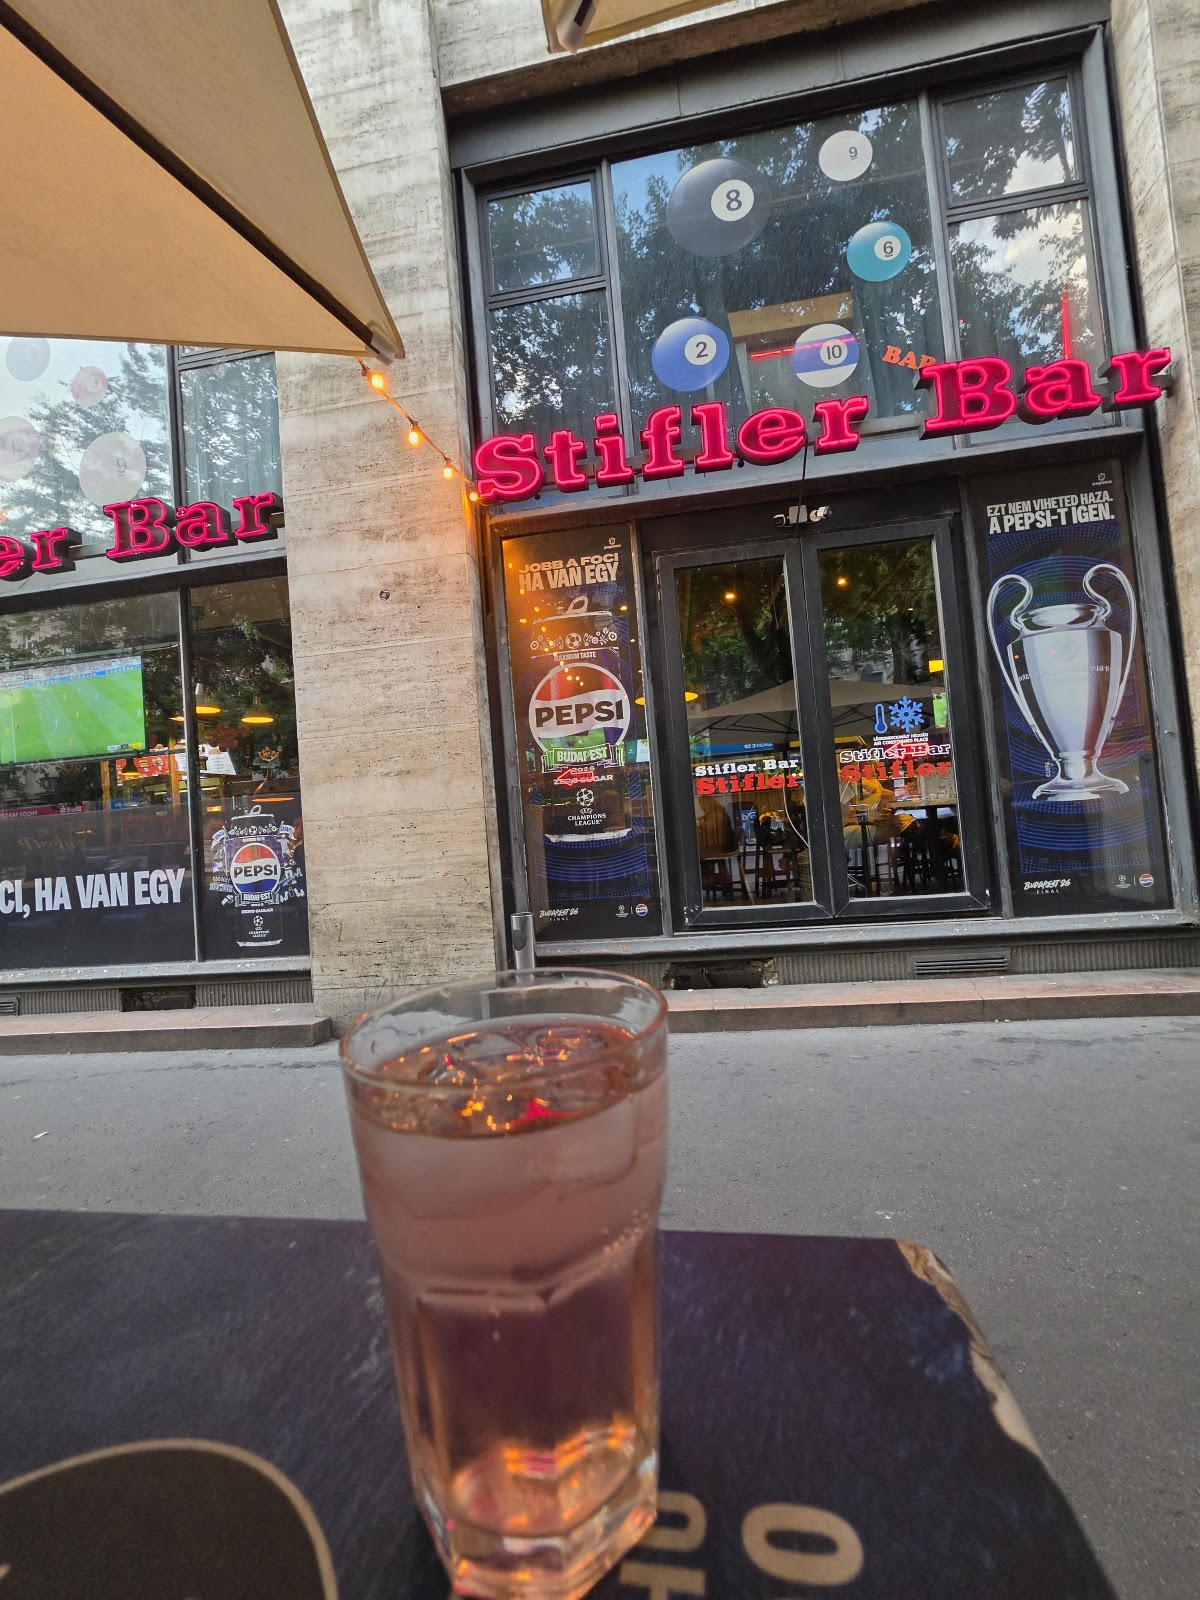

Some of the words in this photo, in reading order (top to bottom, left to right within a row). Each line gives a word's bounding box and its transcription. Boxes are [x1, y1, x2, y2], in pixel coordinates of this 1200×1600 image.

[725, 189, 742, 212] 8
[882, 240, 894, 257] 6
[695, 341, 709, 359] 2
[826, 343, 842, 360] 10
[474, 394, 869, 502] Stifler
[918, 347, 1171, 438] Bar
[986, 503, 1007, 517] EZT
[1008, 500, 1032, 514] NEM
[1033, 494, 1079, 511] VIHETED
[1080, 490, 1114, 505] HAZA.
[103, 492, 280, 562] Bar
[989, 516, 1001, 535] A
[1003, 507, 1068, 532] PEPSI-T
[1071, 502, 1115, 524] IGEN.
[518, 560, 564, 574] JOBB
[566, 558, 579, 568] A
[580, 552, 619, 566] FOCI
[519, 571, 544, 592] HA
[546, 566, 582, 589] VAN
[584, 562, 619, 584] EGY
[534, 699, 624, 728] PEPSI
[556, 747, 608, 763] BUDAPEST
[840, 747, 906, 763] Stifler
[695, 763, 757, 777] Stifler
[762, 759, 799, 771] Bar
[841, 759, 952, 782] Stifler
[695, 772, 801, 795] Stifler
[567, 813, 607, 821] CHAMPIONS
[233, 864, 278, 878] PEPSI
[0, 879, 31, 919] CI,
[34, 876, 72, 912] HA
[75, 872, 129, 909] VAN
[134, 868, 186, 906] EGY
